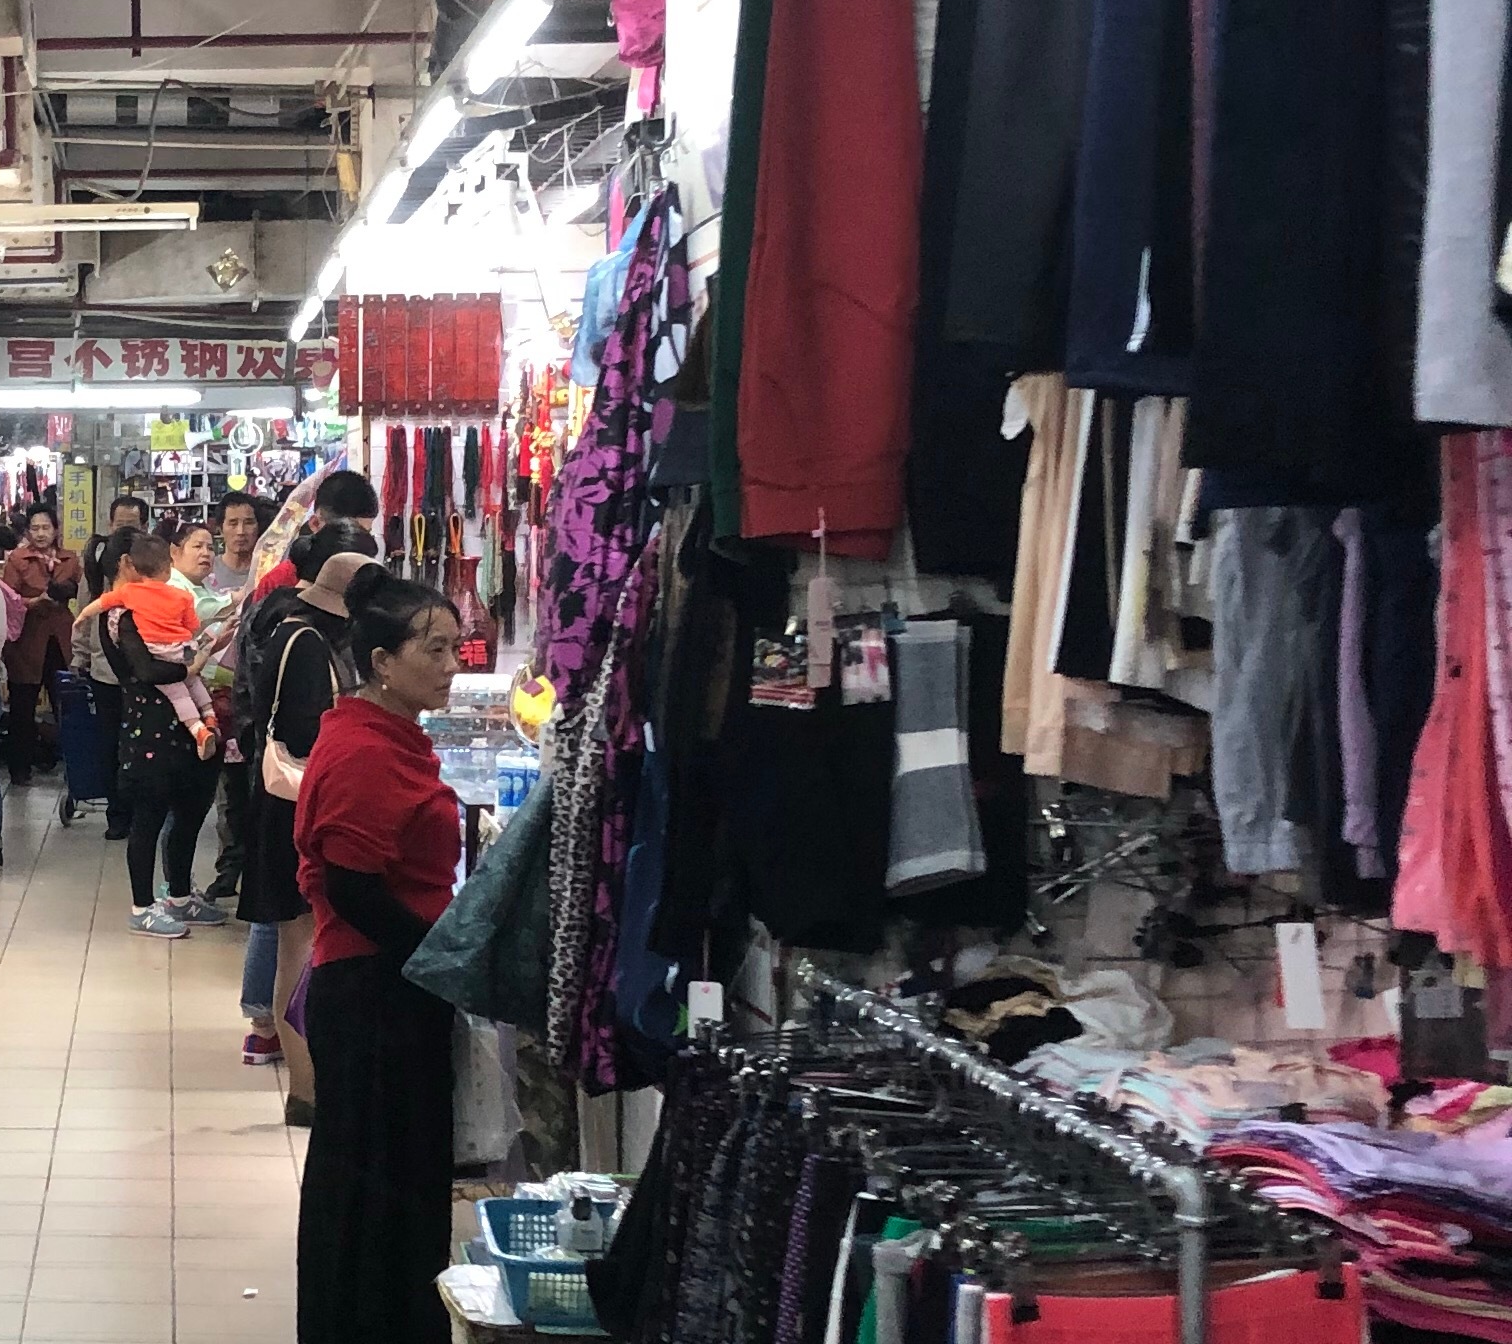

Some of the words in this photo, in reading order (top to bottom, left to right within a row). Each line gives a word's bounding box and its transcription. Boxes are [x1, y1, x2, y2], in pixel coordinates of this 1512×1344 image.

[69, 471, 88, 540] 手机电池
[459, 639, 487, 666] 福
[188, 904, 201, 917] N
[141, 916, 155, 929] N
